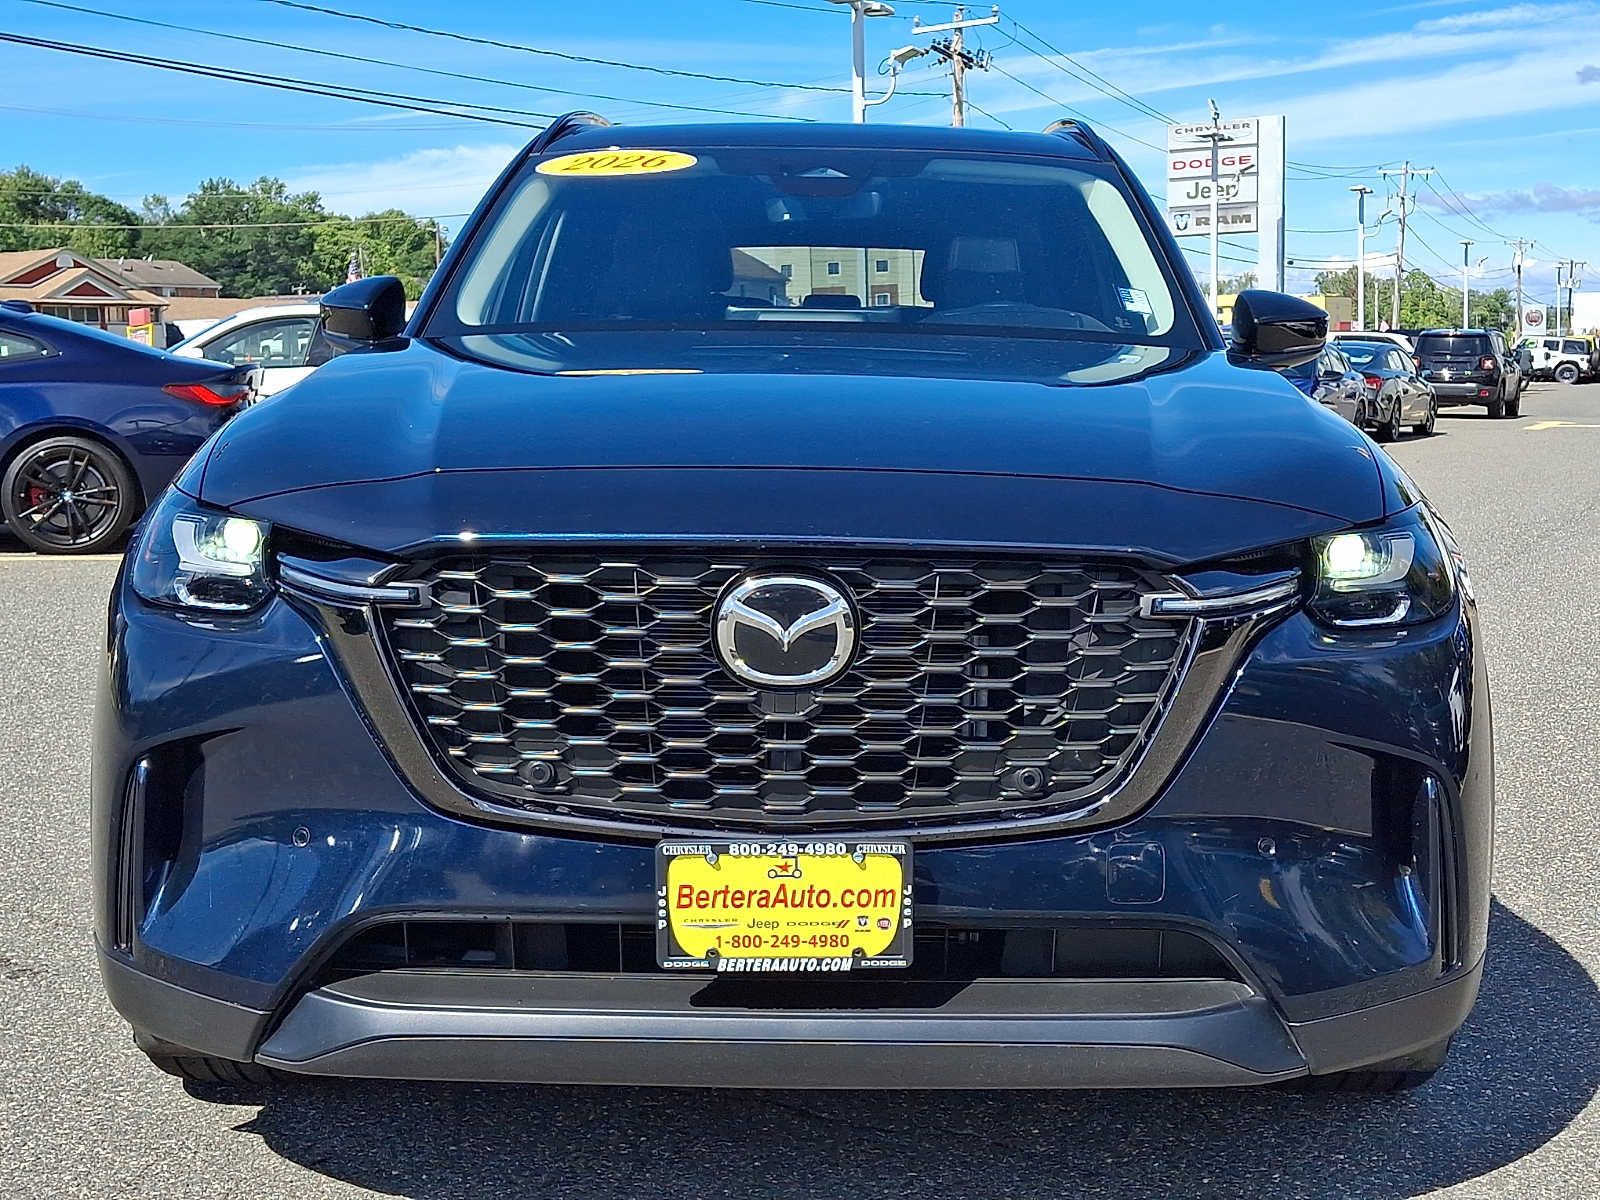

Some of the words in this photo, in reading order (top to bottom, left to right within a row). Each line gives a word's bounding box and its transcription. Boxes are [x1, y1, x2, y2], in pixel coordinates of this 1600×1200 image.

[561, 154, 676, 171] 2026
[662, 844, 713, 857] CHRYSLER
[728, 842, 847, 856] 800-249-4980
[855, 844, 907, 855] CHRYSLER
[676, 883, 897, 910] BerteraAuto.com
[657, 885, 668, 930] Jeep
[902, 884, 913, 929] Jeep
[747, 918, 780, 930] Jeep
[715, 934, 850, 949] 1-800-249-4980
[716, 957, 854, 972] BERTERAAUTO.COM
